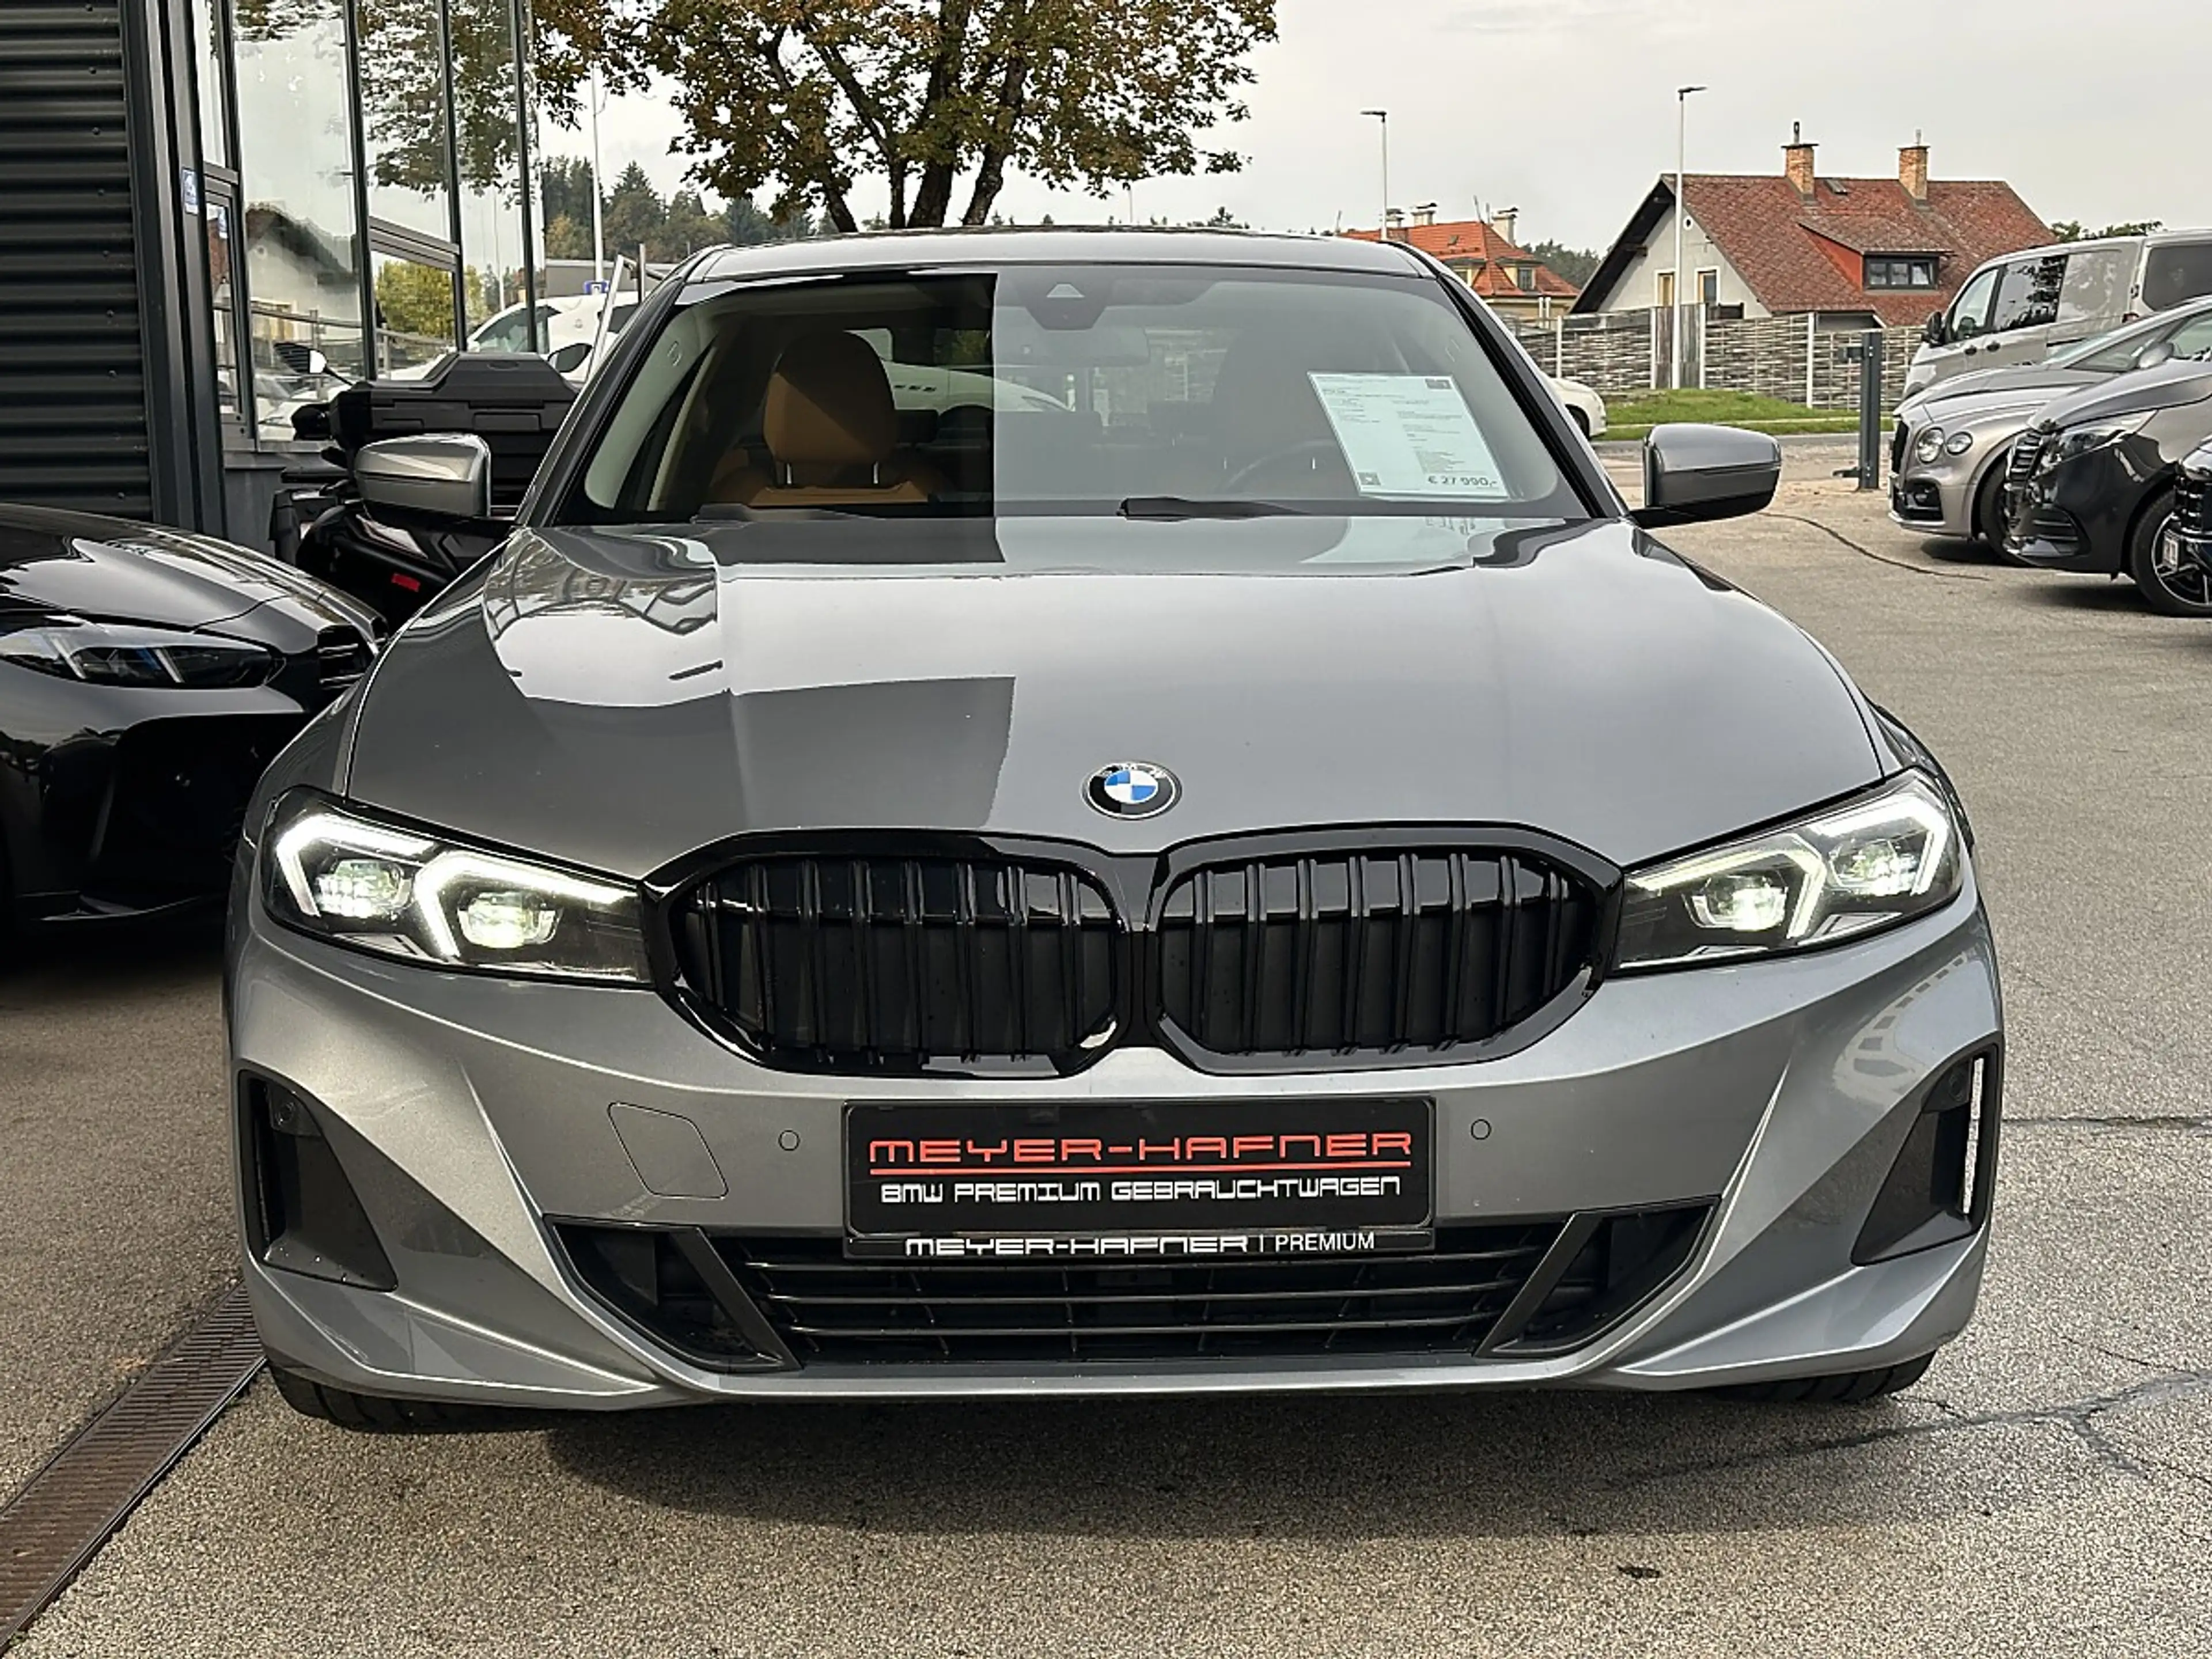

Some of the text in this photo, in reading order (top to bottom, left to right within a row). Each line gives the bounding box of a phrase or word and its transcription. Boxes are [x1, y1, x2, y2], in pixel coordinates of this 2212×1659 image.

[870, 1132, 1411, 1161] MEYER-HAFNER
[880, 1176, 1400, 1203] BMW PREMIUM GEBRAUCHTWAGEN
[906, 1232, 1375, 1256] MEYER-HAFNER PREMIUM
